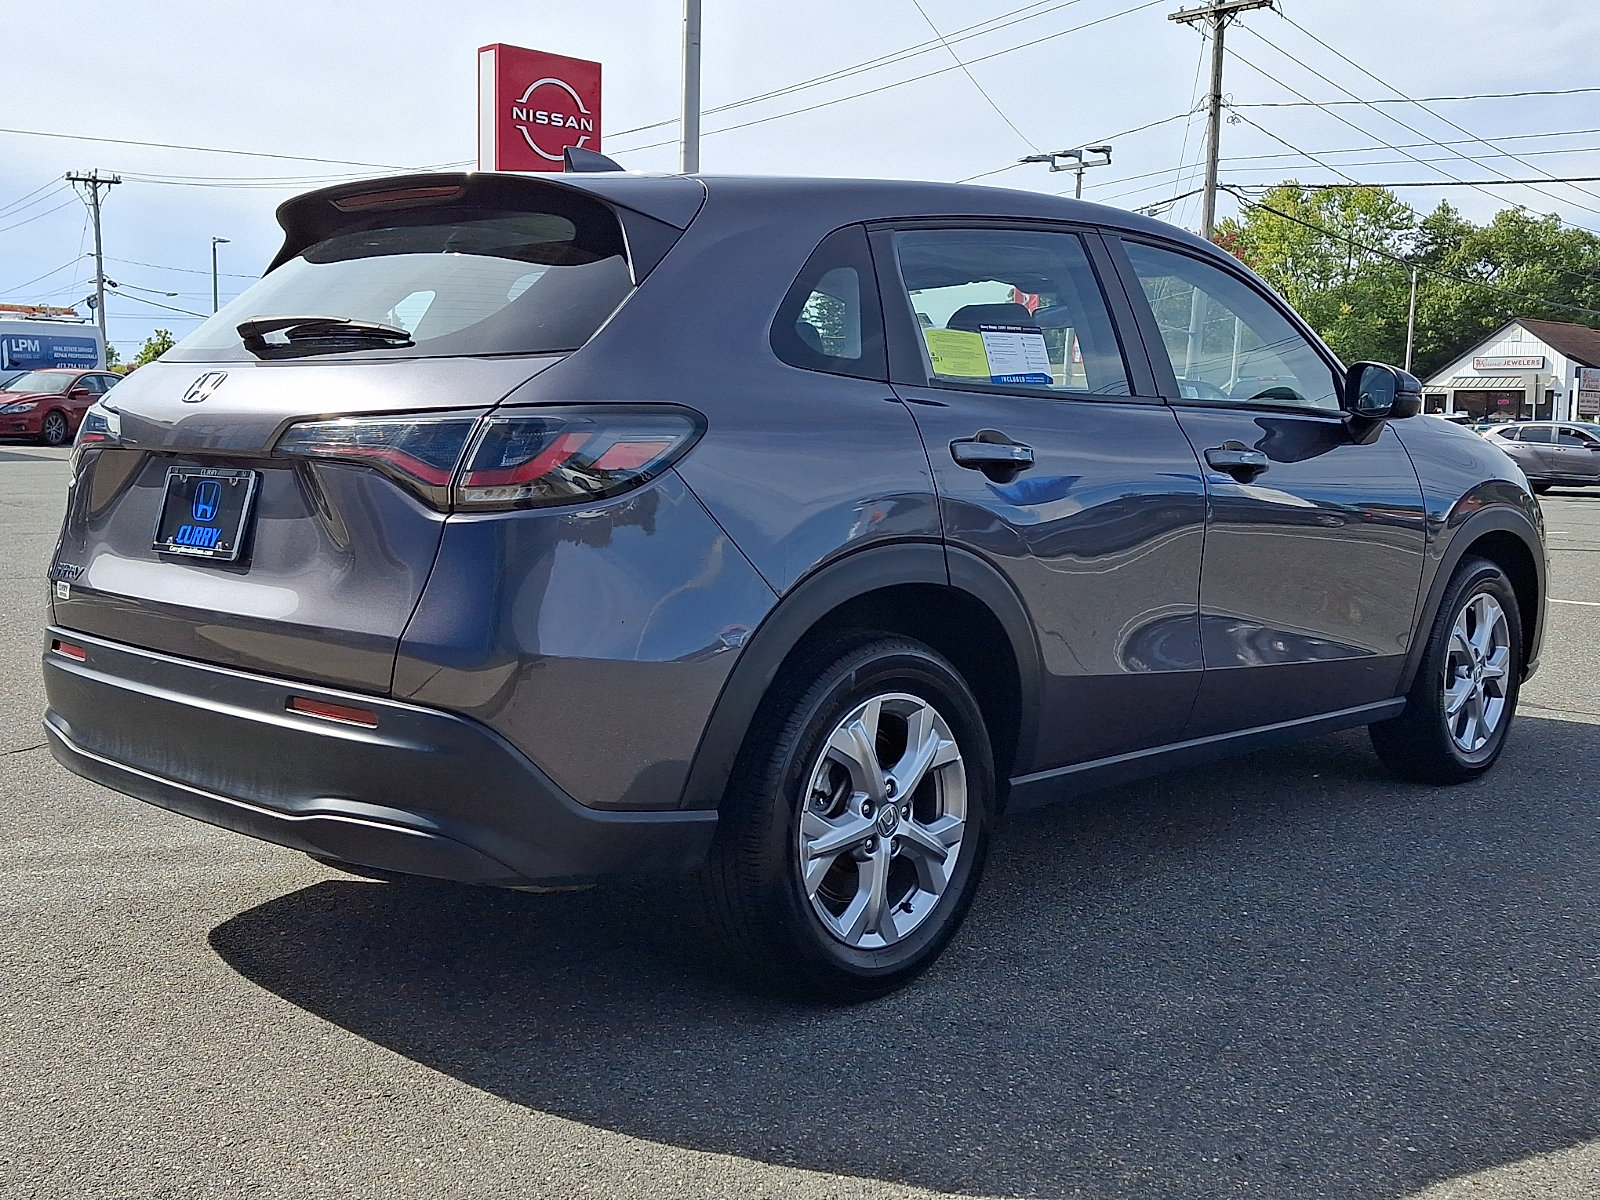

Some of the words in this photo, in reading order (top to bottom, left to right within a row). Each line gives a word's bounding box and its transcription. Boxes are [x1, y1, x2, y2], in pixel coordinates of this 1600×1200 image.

[512, 106, 593, 132] NISSAN
[12, 339, 40, 352] LPM
[177, 525, 222, 546] CURRY
